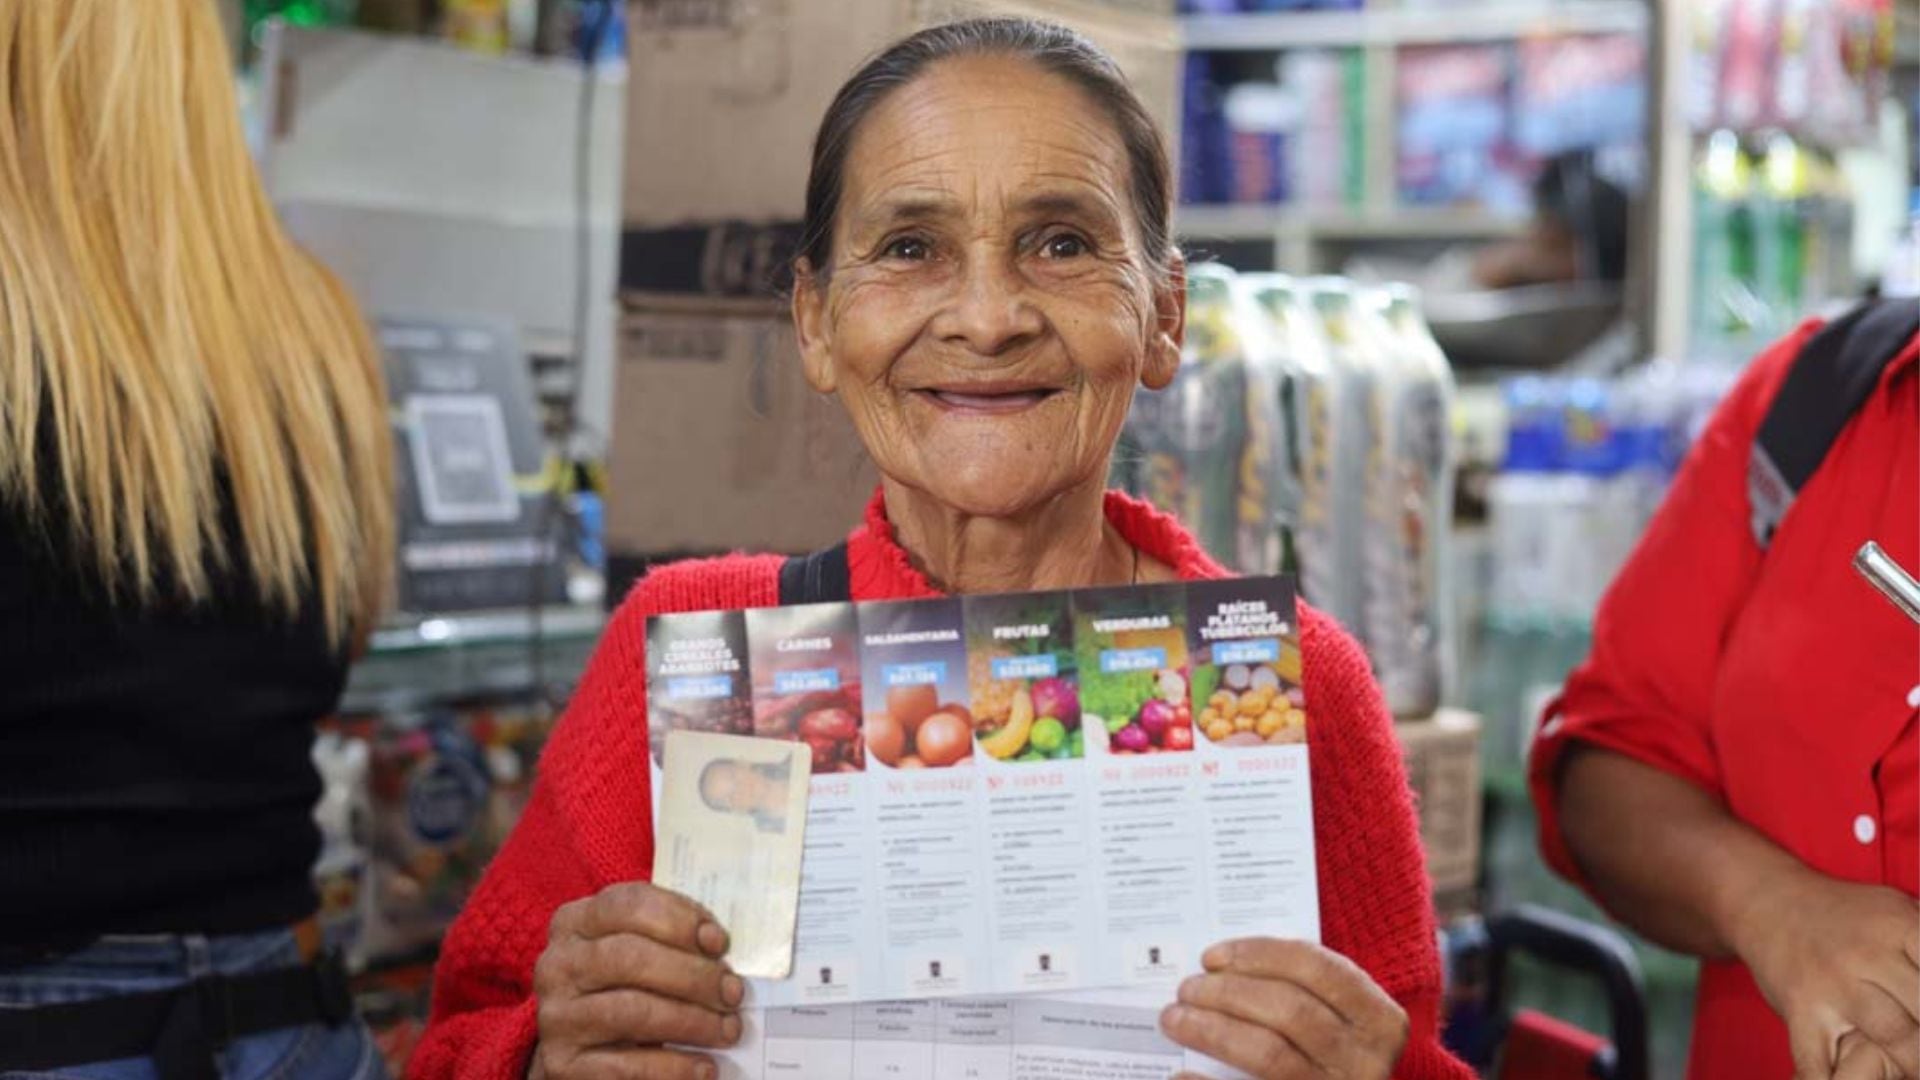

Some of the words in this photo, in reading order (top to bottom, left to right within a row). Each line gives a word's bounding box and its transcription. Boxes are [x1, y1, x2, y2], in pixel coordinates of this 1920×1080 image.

[993, 624, 1049, 639] FRUTAS
[1093, 616, 1170, 632] VERDURAS
[776, 637, 832, 651] CARNES
[865, 629, 959, 645] SALSAMENTARIA
